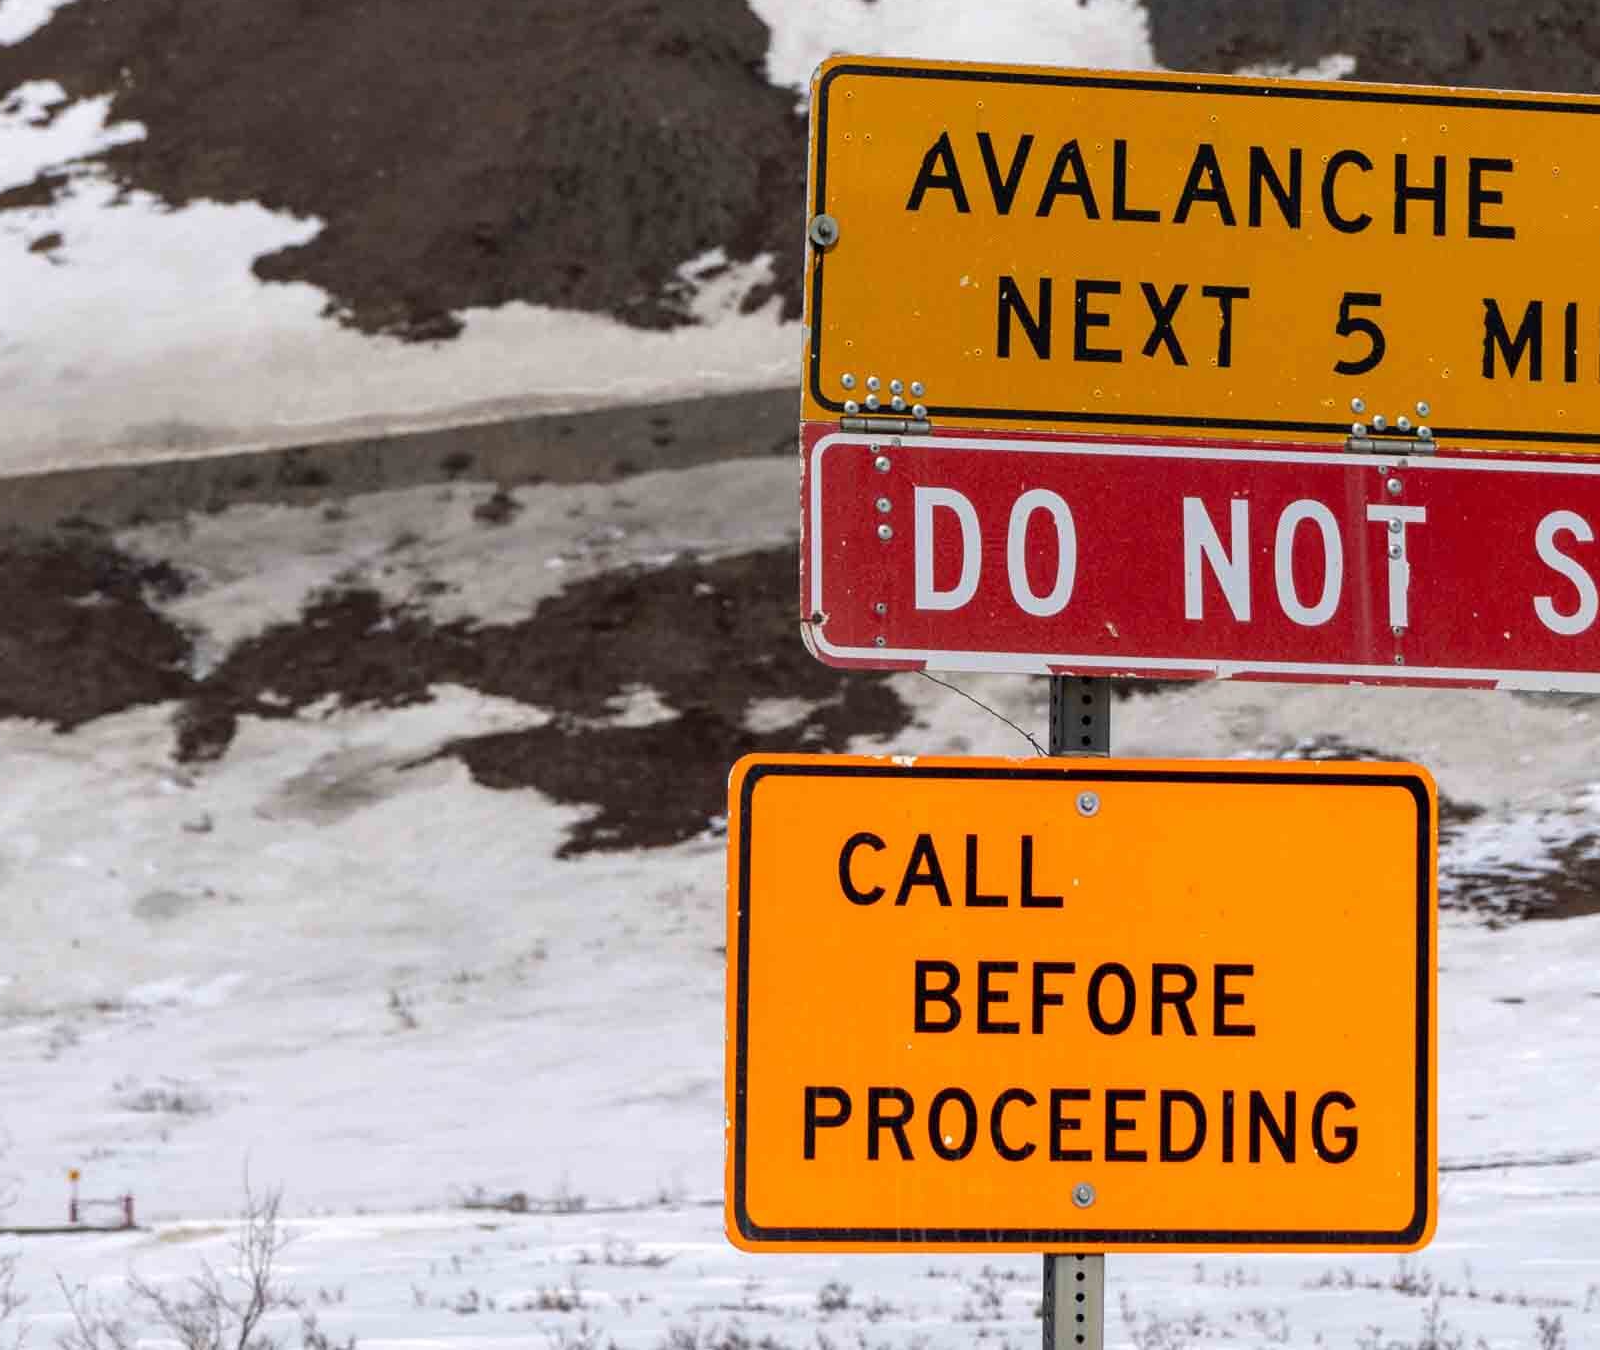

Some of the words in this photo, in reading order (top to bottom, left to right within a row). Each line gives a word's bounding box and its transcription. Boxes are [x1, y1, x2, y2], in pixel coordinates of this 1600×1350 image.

[907, 132, 1515, 239] AVALANCHE
[998, 277, 1249, 367] NEXT
[1334, 293, 1385, 375] 5
[915, 487, 1076, 616] DO
[1184, 497, 1425, 629] NOT
[839, 833, 1063, 908] CALL
[914, 960, 1255, 1036] BEFORE
[804, 1087, 1358, 1163] PROCEEDING
